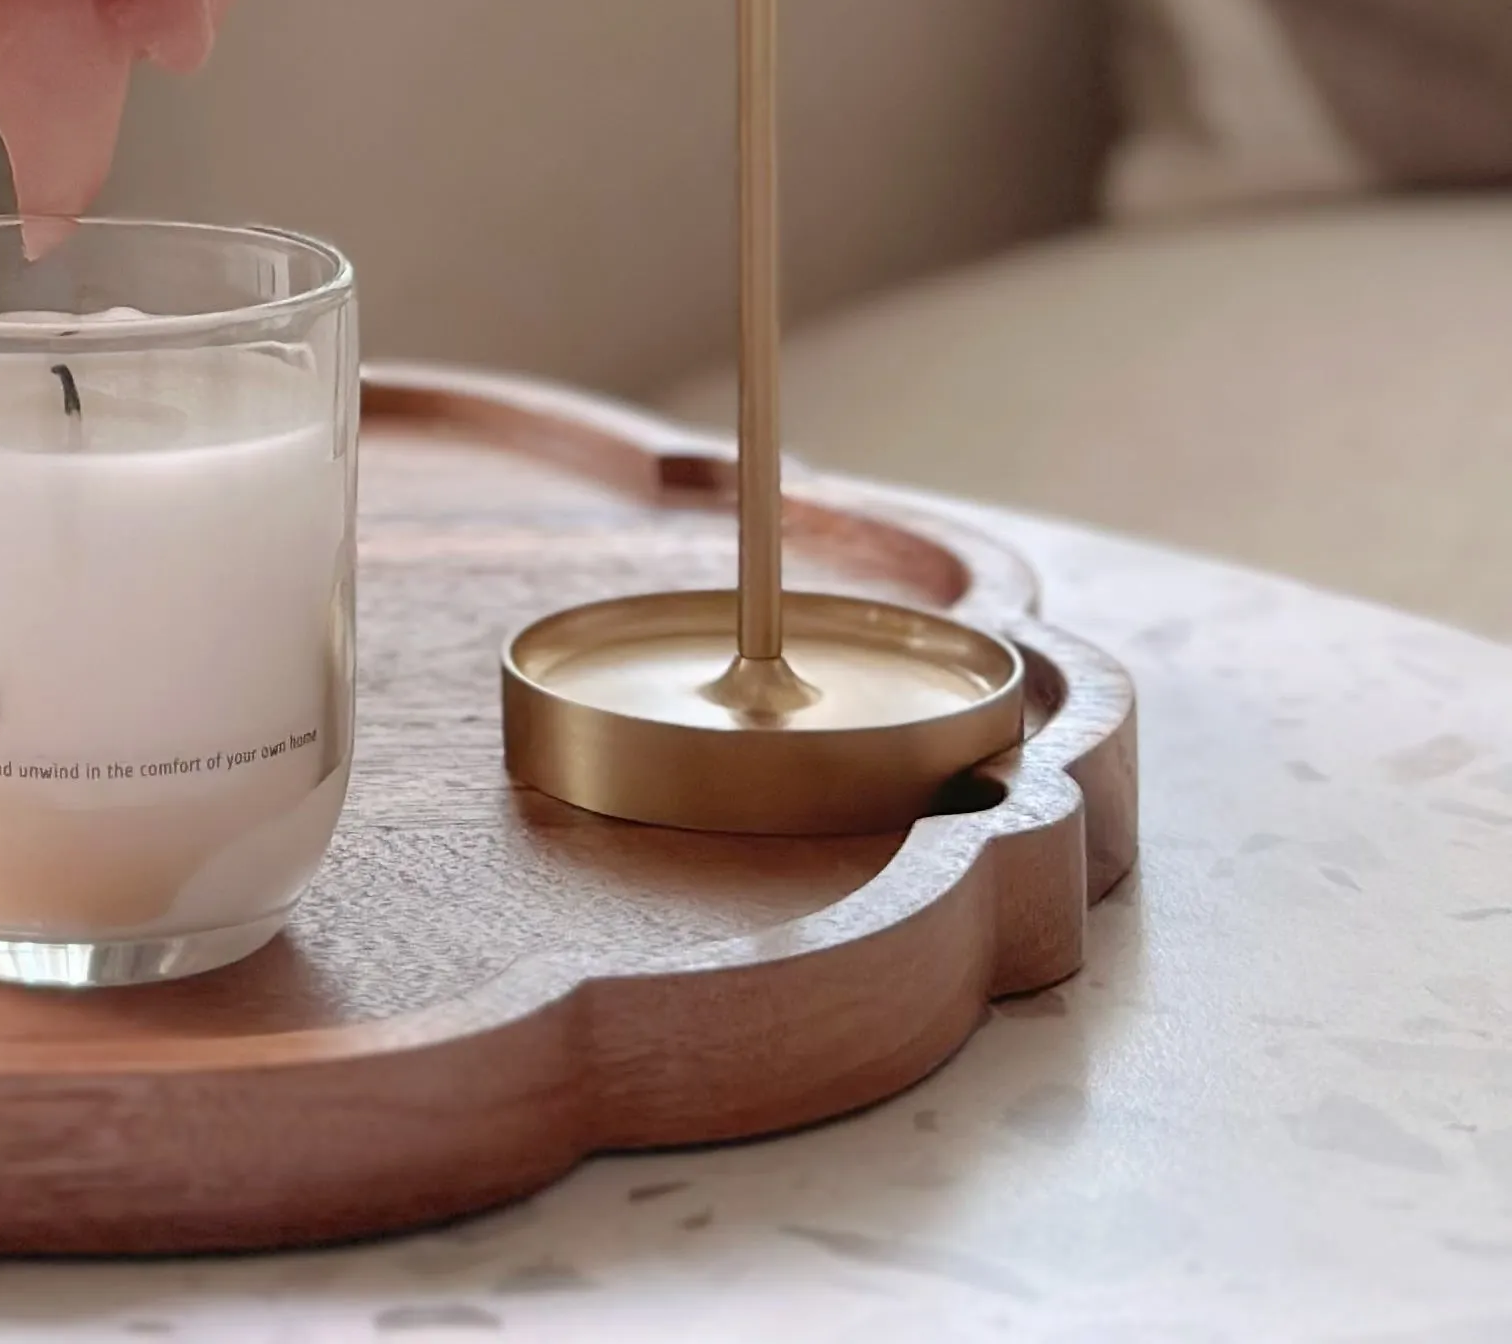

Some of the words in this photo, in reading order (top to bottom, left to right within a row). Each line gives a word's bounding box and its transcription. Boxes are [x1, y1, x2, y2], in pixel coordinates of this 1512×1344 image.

[19, 762, 80, 780] unwind
[86, 763, 101, 780] in
[107, 762, 134, 780] the
[140, 757, 201, 777] comfort
[207, 752, 222, 770] of
[226, 748, 258, 770] your
[261, 739, 286, 759] own
[290, 728, 318, 750] home
